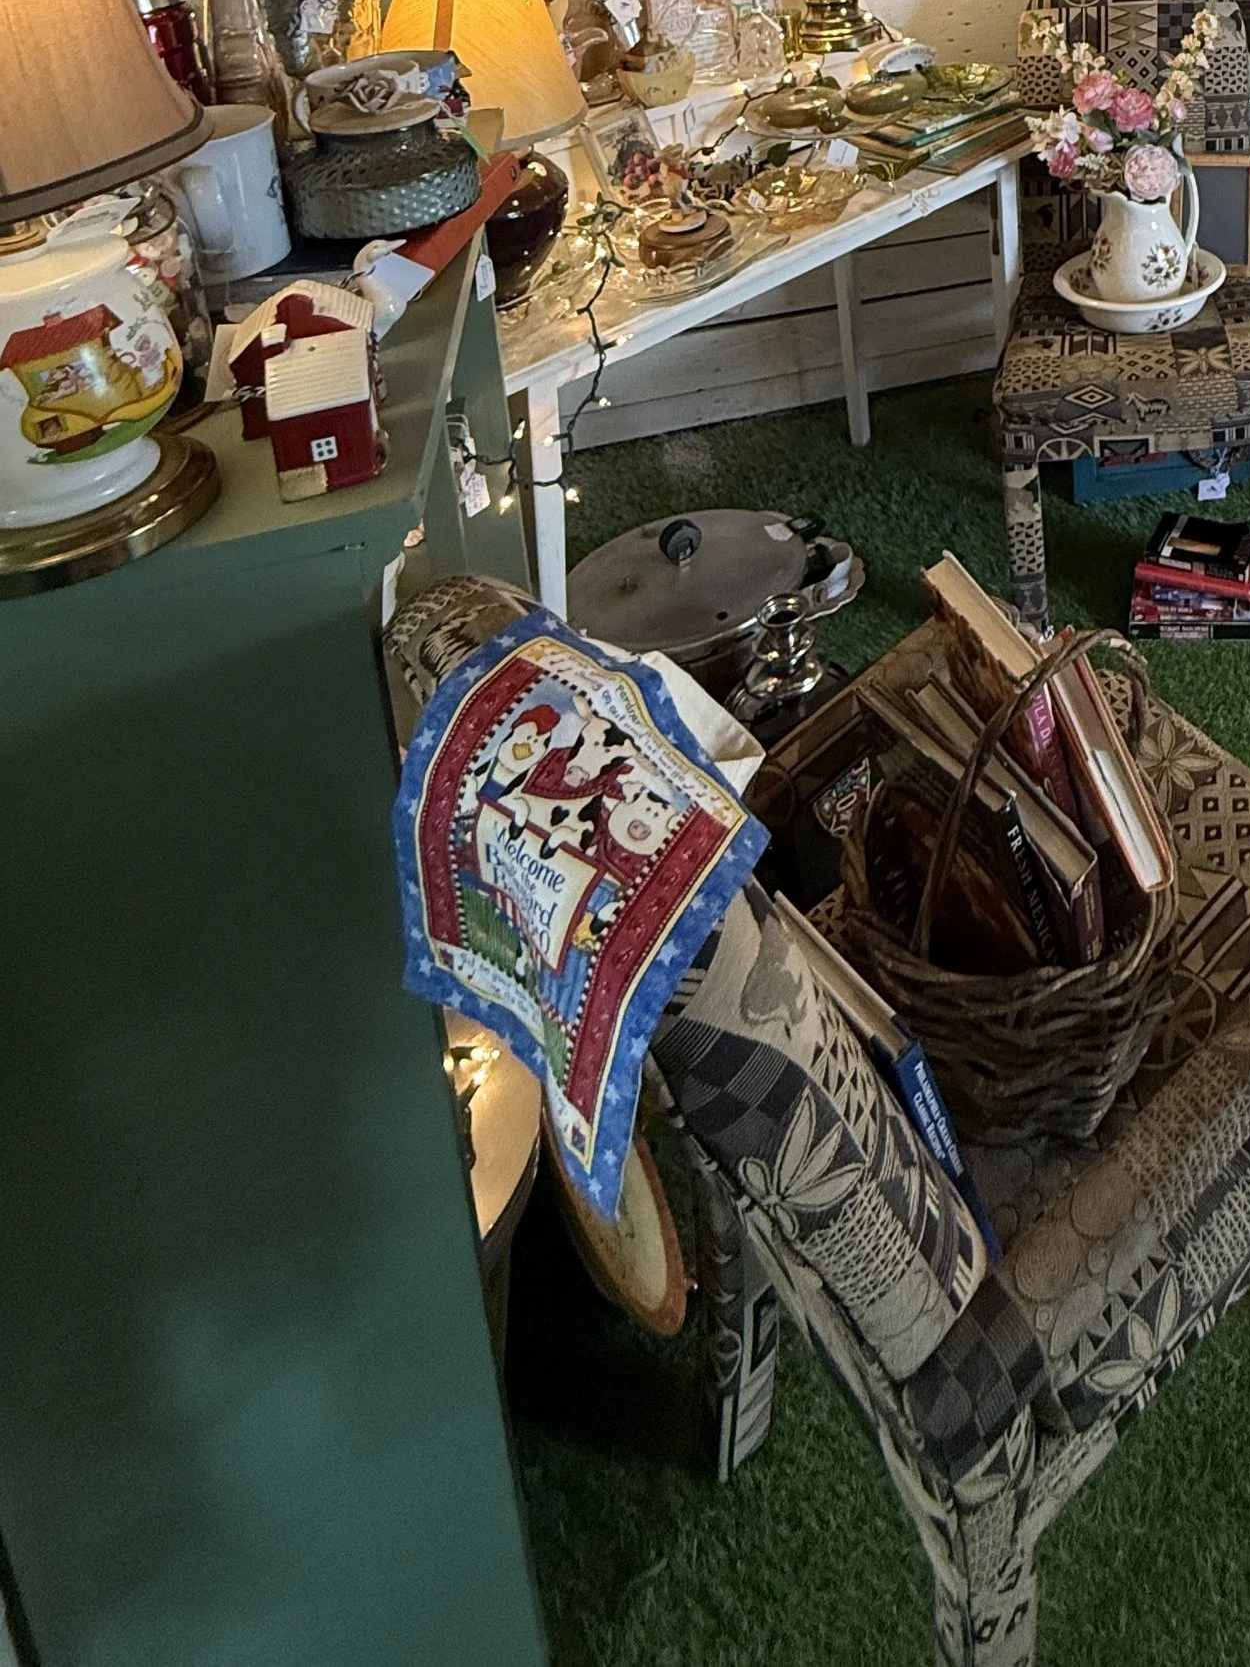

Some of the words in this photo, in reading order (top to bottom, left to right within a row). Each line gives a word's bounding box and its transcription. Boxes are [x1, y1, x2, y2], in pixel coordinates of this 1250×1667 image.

[494, 820, 566, 894] Welcome
[1006, 824, 1033, 886] FRESH
[913, 1091, 932, 1127] CLASSIC
